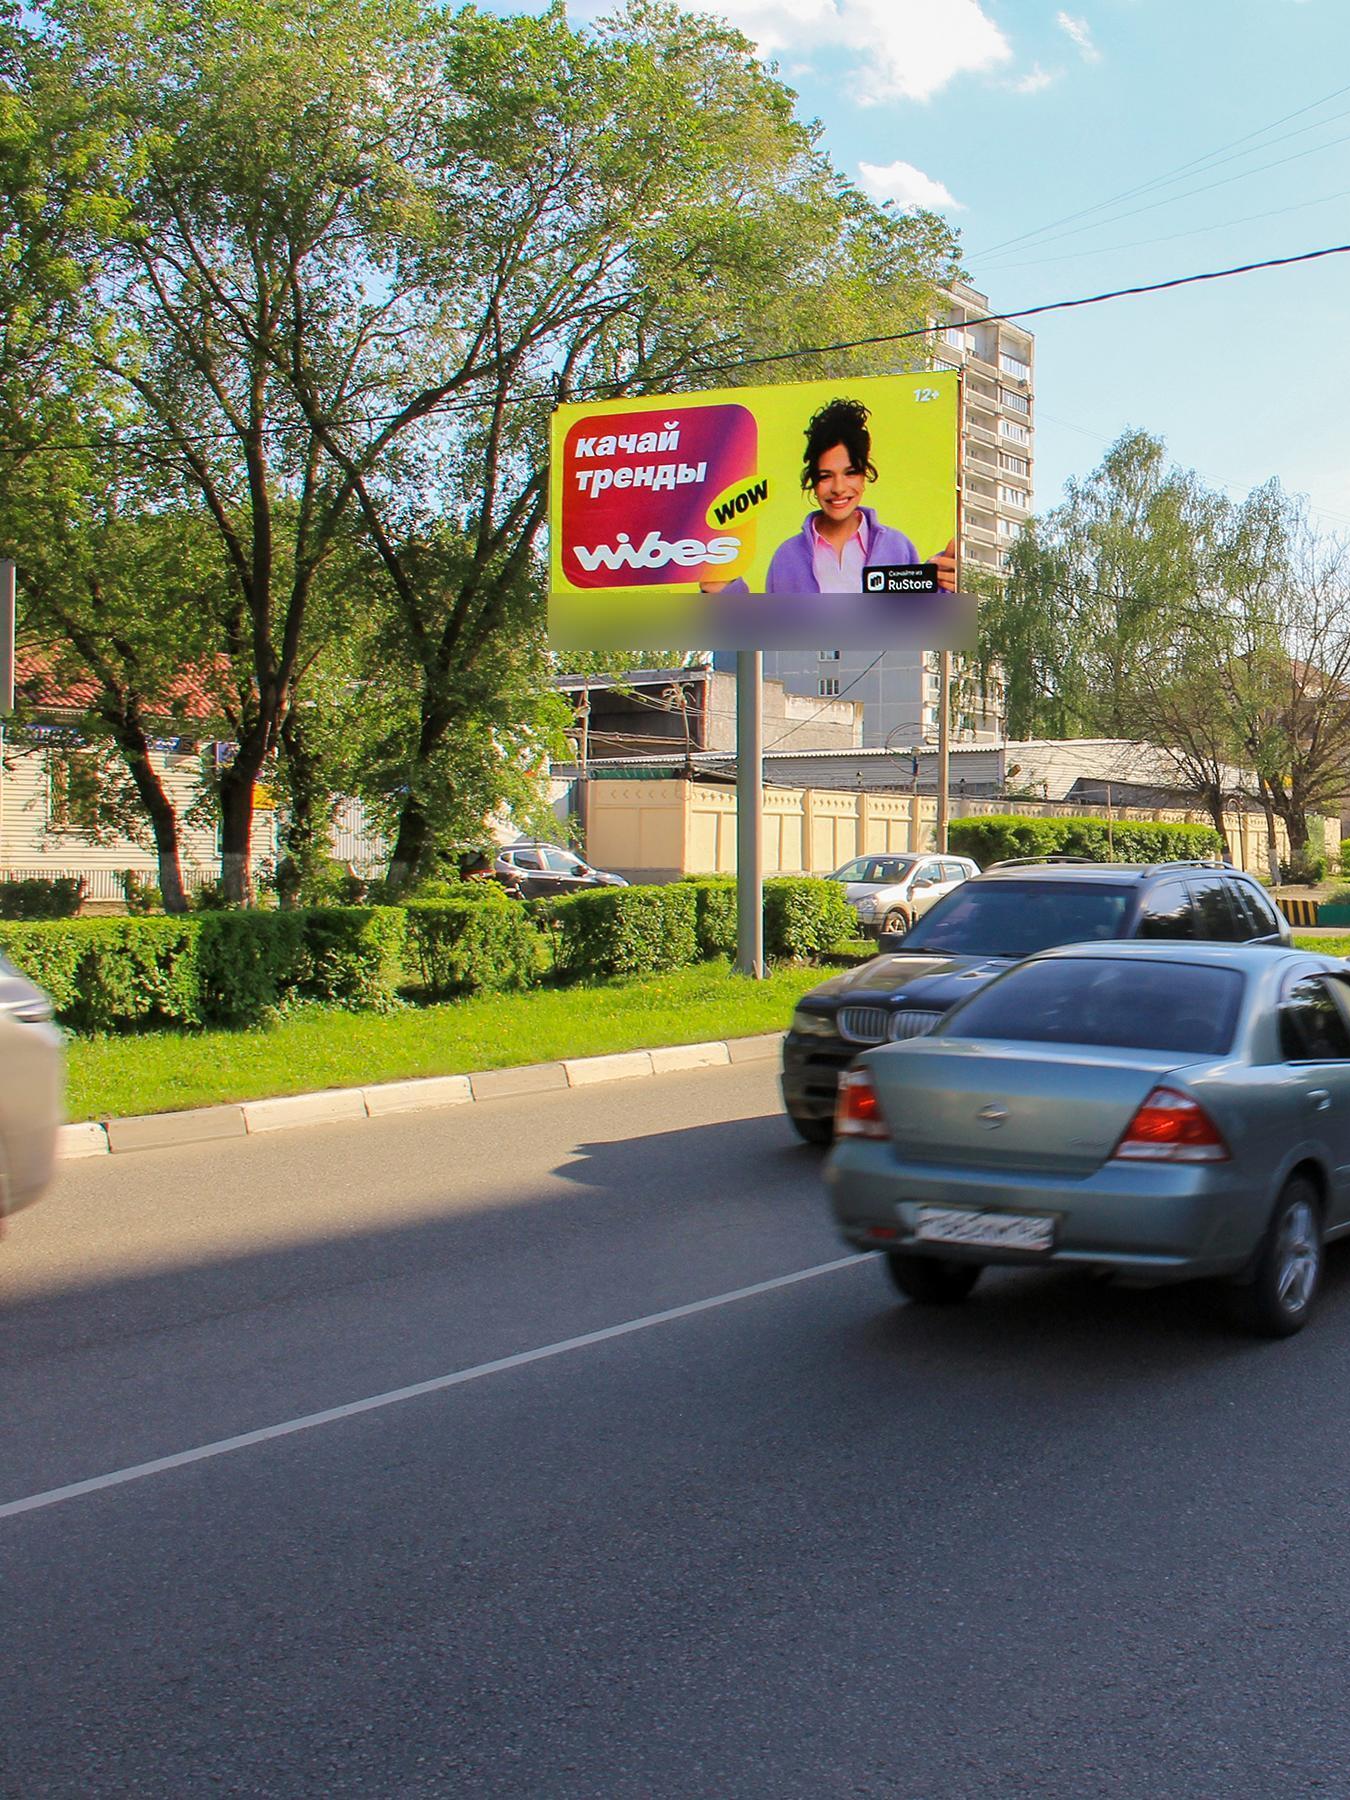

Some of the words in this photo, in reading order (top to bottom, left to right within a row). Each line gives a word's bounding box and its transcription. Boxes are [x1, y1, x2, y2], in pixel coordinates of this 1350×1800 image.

[913, 388, 940, 402] 12+
[574, 420, 680, 458] качай
[575, 461, 708, 498] тренды
[573, 531, 742, 571] wibes
[888, 578, 933, 591] RuStore
